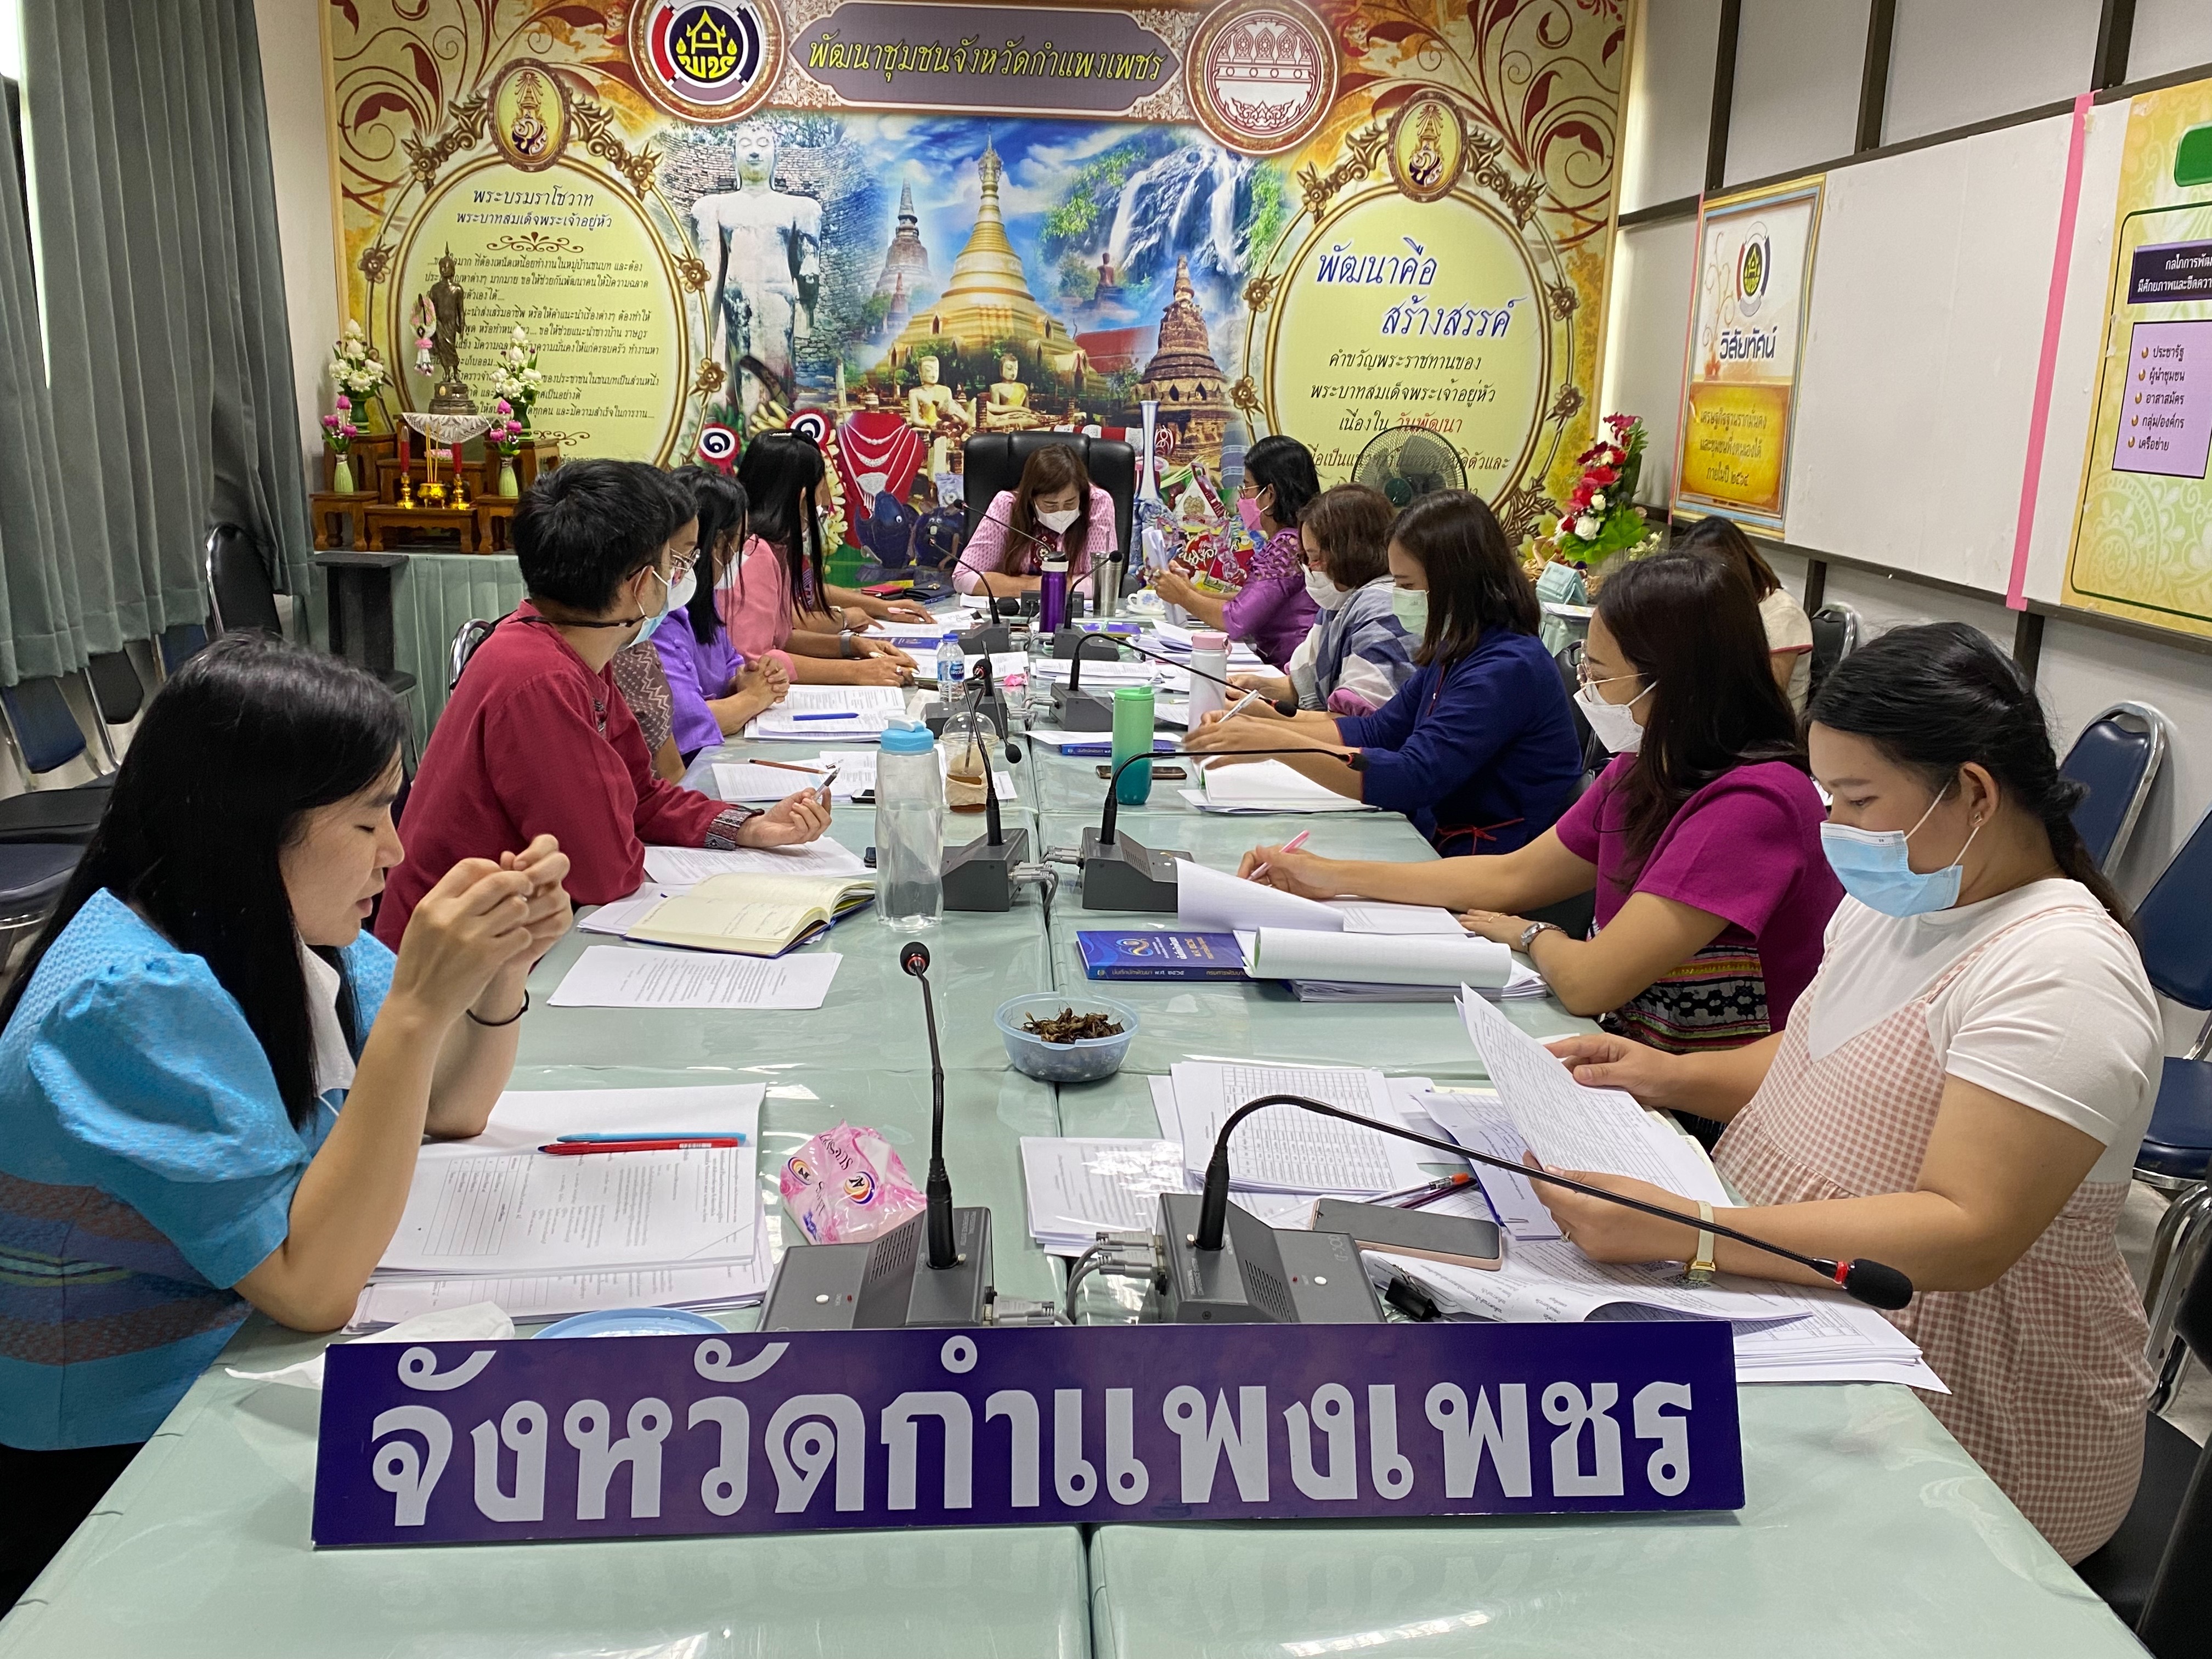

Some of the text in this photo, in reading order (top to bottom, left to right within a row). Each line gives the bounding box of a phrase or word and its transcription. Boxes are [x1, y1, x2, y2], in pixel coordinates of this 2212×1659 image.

[808, 30, 1167, 82] พัฒนาชุมชนจังหวัดกำแพงเพชร
[473, 185, 594, 207] พระบรมราโชวาท
[457, 211, 612, 231] พระบาทสมเด็จพระเจ้าอยู่หัว
[614, 259, 643, 272] และต้อง
[1317, 236, 1437, 285] พัฒนาคือ
[1381, 294, 1528, 337] สร้างสรรค์
[1719, 325, 1778, 359] วิสัยทัศน์
[2153, 344, 2185, 362] ประชารัฐ
[1329, 349, 1482, 371] คำขวัญพระราชทานของ
[2149, 366, 2185, 385] ผู้นำชุมชน
[1311, 380, 1497, 408] พระบาทสมเด็จพระเจ้าอยู่หัว
[2146, 391, 2185, 404] อาสาสมัคร
[1339, 408, 1389, 431] เนื่องใน
[2142, 413, 2185, 431] กลุ่ม/องค์กร
[2138, 436, 2170, 450] เครือข่าย
[371, 1335, 1692, 1526] จังหวัดกำแพงเพชร
